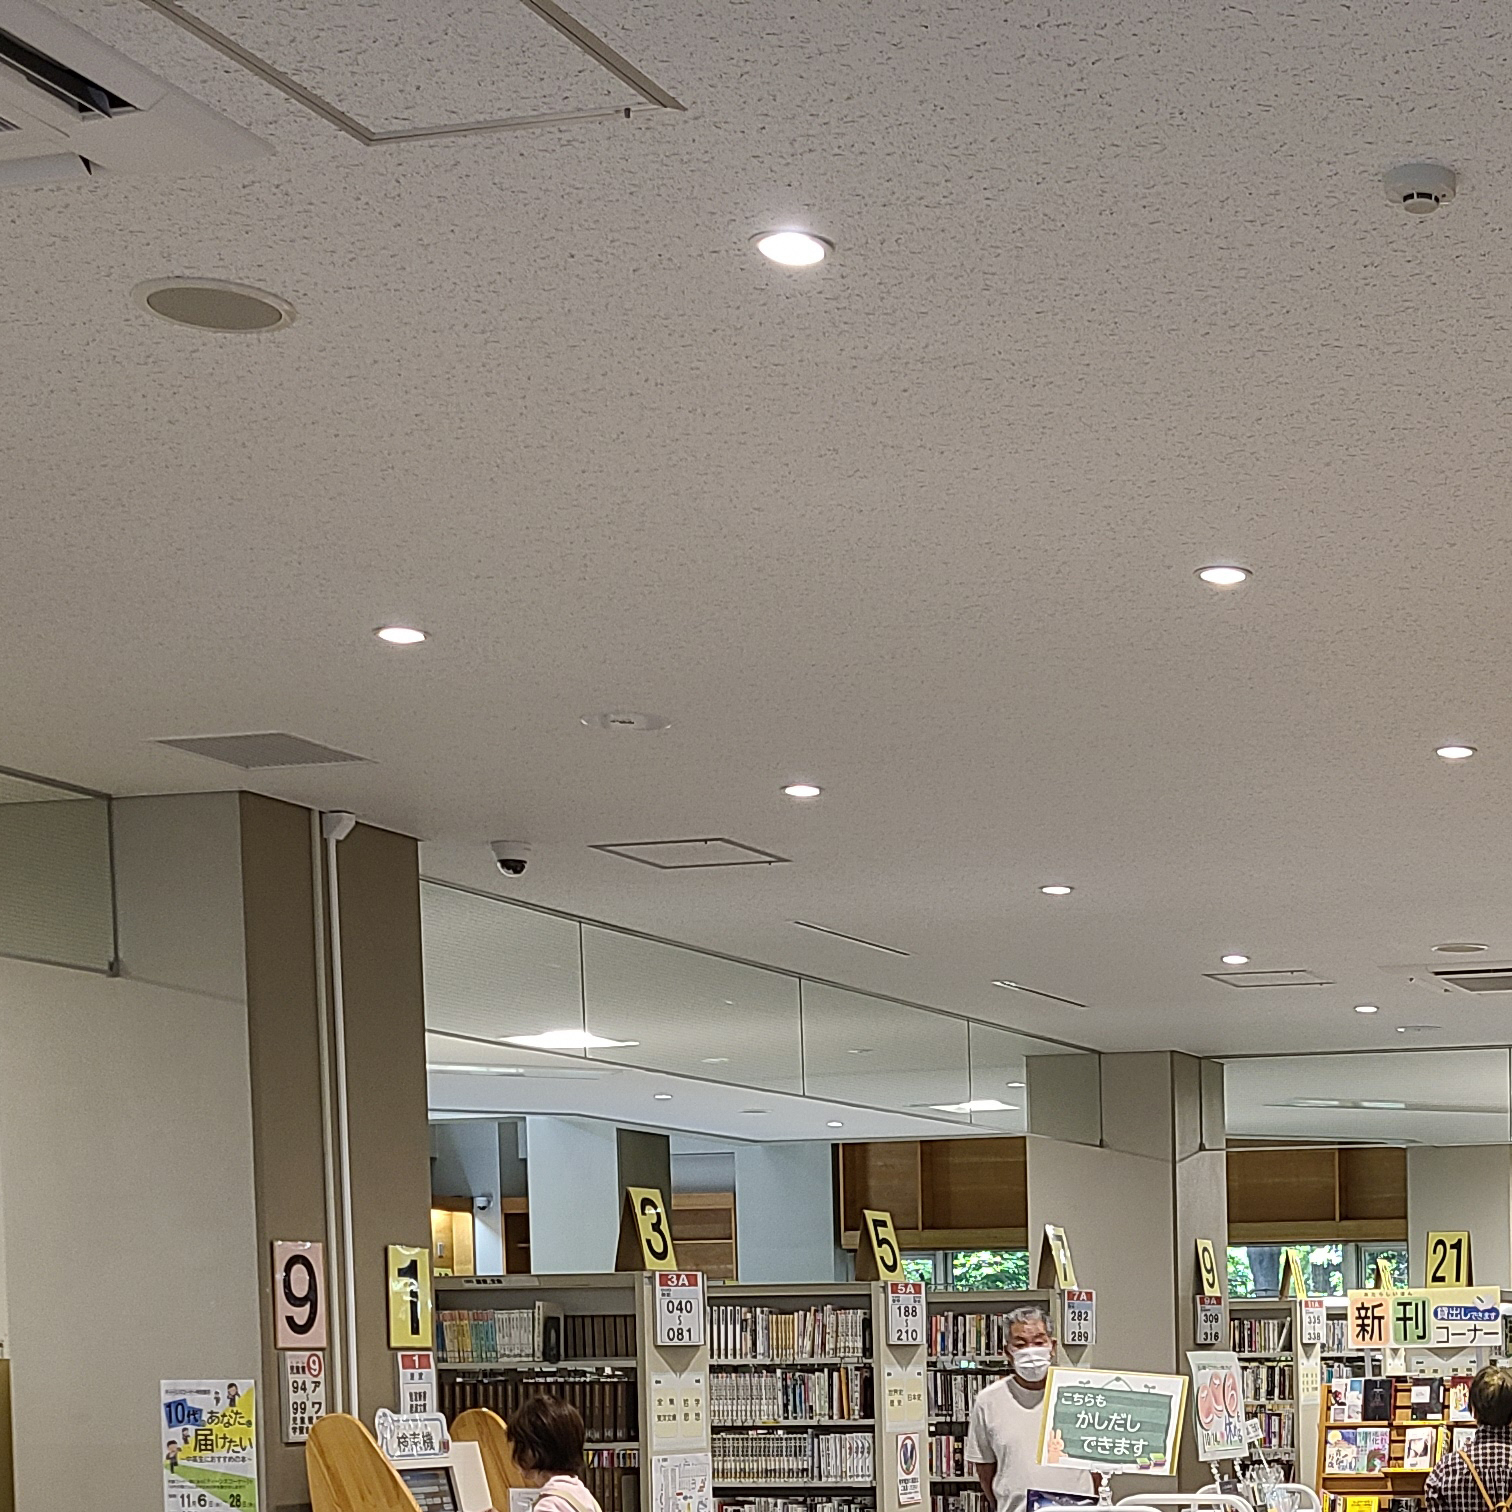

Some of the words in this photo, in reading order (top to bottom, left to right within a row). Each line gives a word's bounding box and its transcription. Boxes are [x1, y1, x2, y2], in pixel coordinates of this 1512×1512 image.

[640, 1197, 669, 1261] 3
[872, 1219, 898, 1273] 5
[1201, 1246, 1216, 1289] 9
[1431, 1238, 1463, 1283] 21
[666, 1274, 690, 1287] 3A
[283, 1254, 318, 1335] 9
[897, 1283, 916, 1294] 5A
[1072, 1291, 1087, 1301] 7A
[397, 1259, 420, 1336] 1
[666, 1300, 693, 1314] 040
[897, 1305, 918, 1318] 188
[1436, 1306, 1497, 1320] 貸出しできます
[1070, 1310, 1089, 1322] 282
[1203, 1313, 1219, 1323] 309
[1307, 1315, 1321, 1325] 335
[1355, 1300, 1426, 1342] 新刊
[1435, 1324, 1499, 1344] コーナー
[666, 1327, 693, 1342] 081
[896, 1330, 918, 1341] 210
[1070, 1330, 1089, 1342] 289
[1203, 1332, 1219, 1342] 316
[1307, 1332, 1321, 1341] 338
[291, 1379, 307, 1394] 94
[311, 1380, 322, 1394] ア
[1061, 1392, 1107, 1407] こちらも
[291, 1401, 307, 1416] 99
[311, 1401, 323, 1416] ワ
[1075, 1411, 1141, 1433] かしだし
[193, 1428, 254, 1454] 届けたい
[396, 1431, 435, 1452] 検索機
[1081, 1436, 1149, 1457] できます
